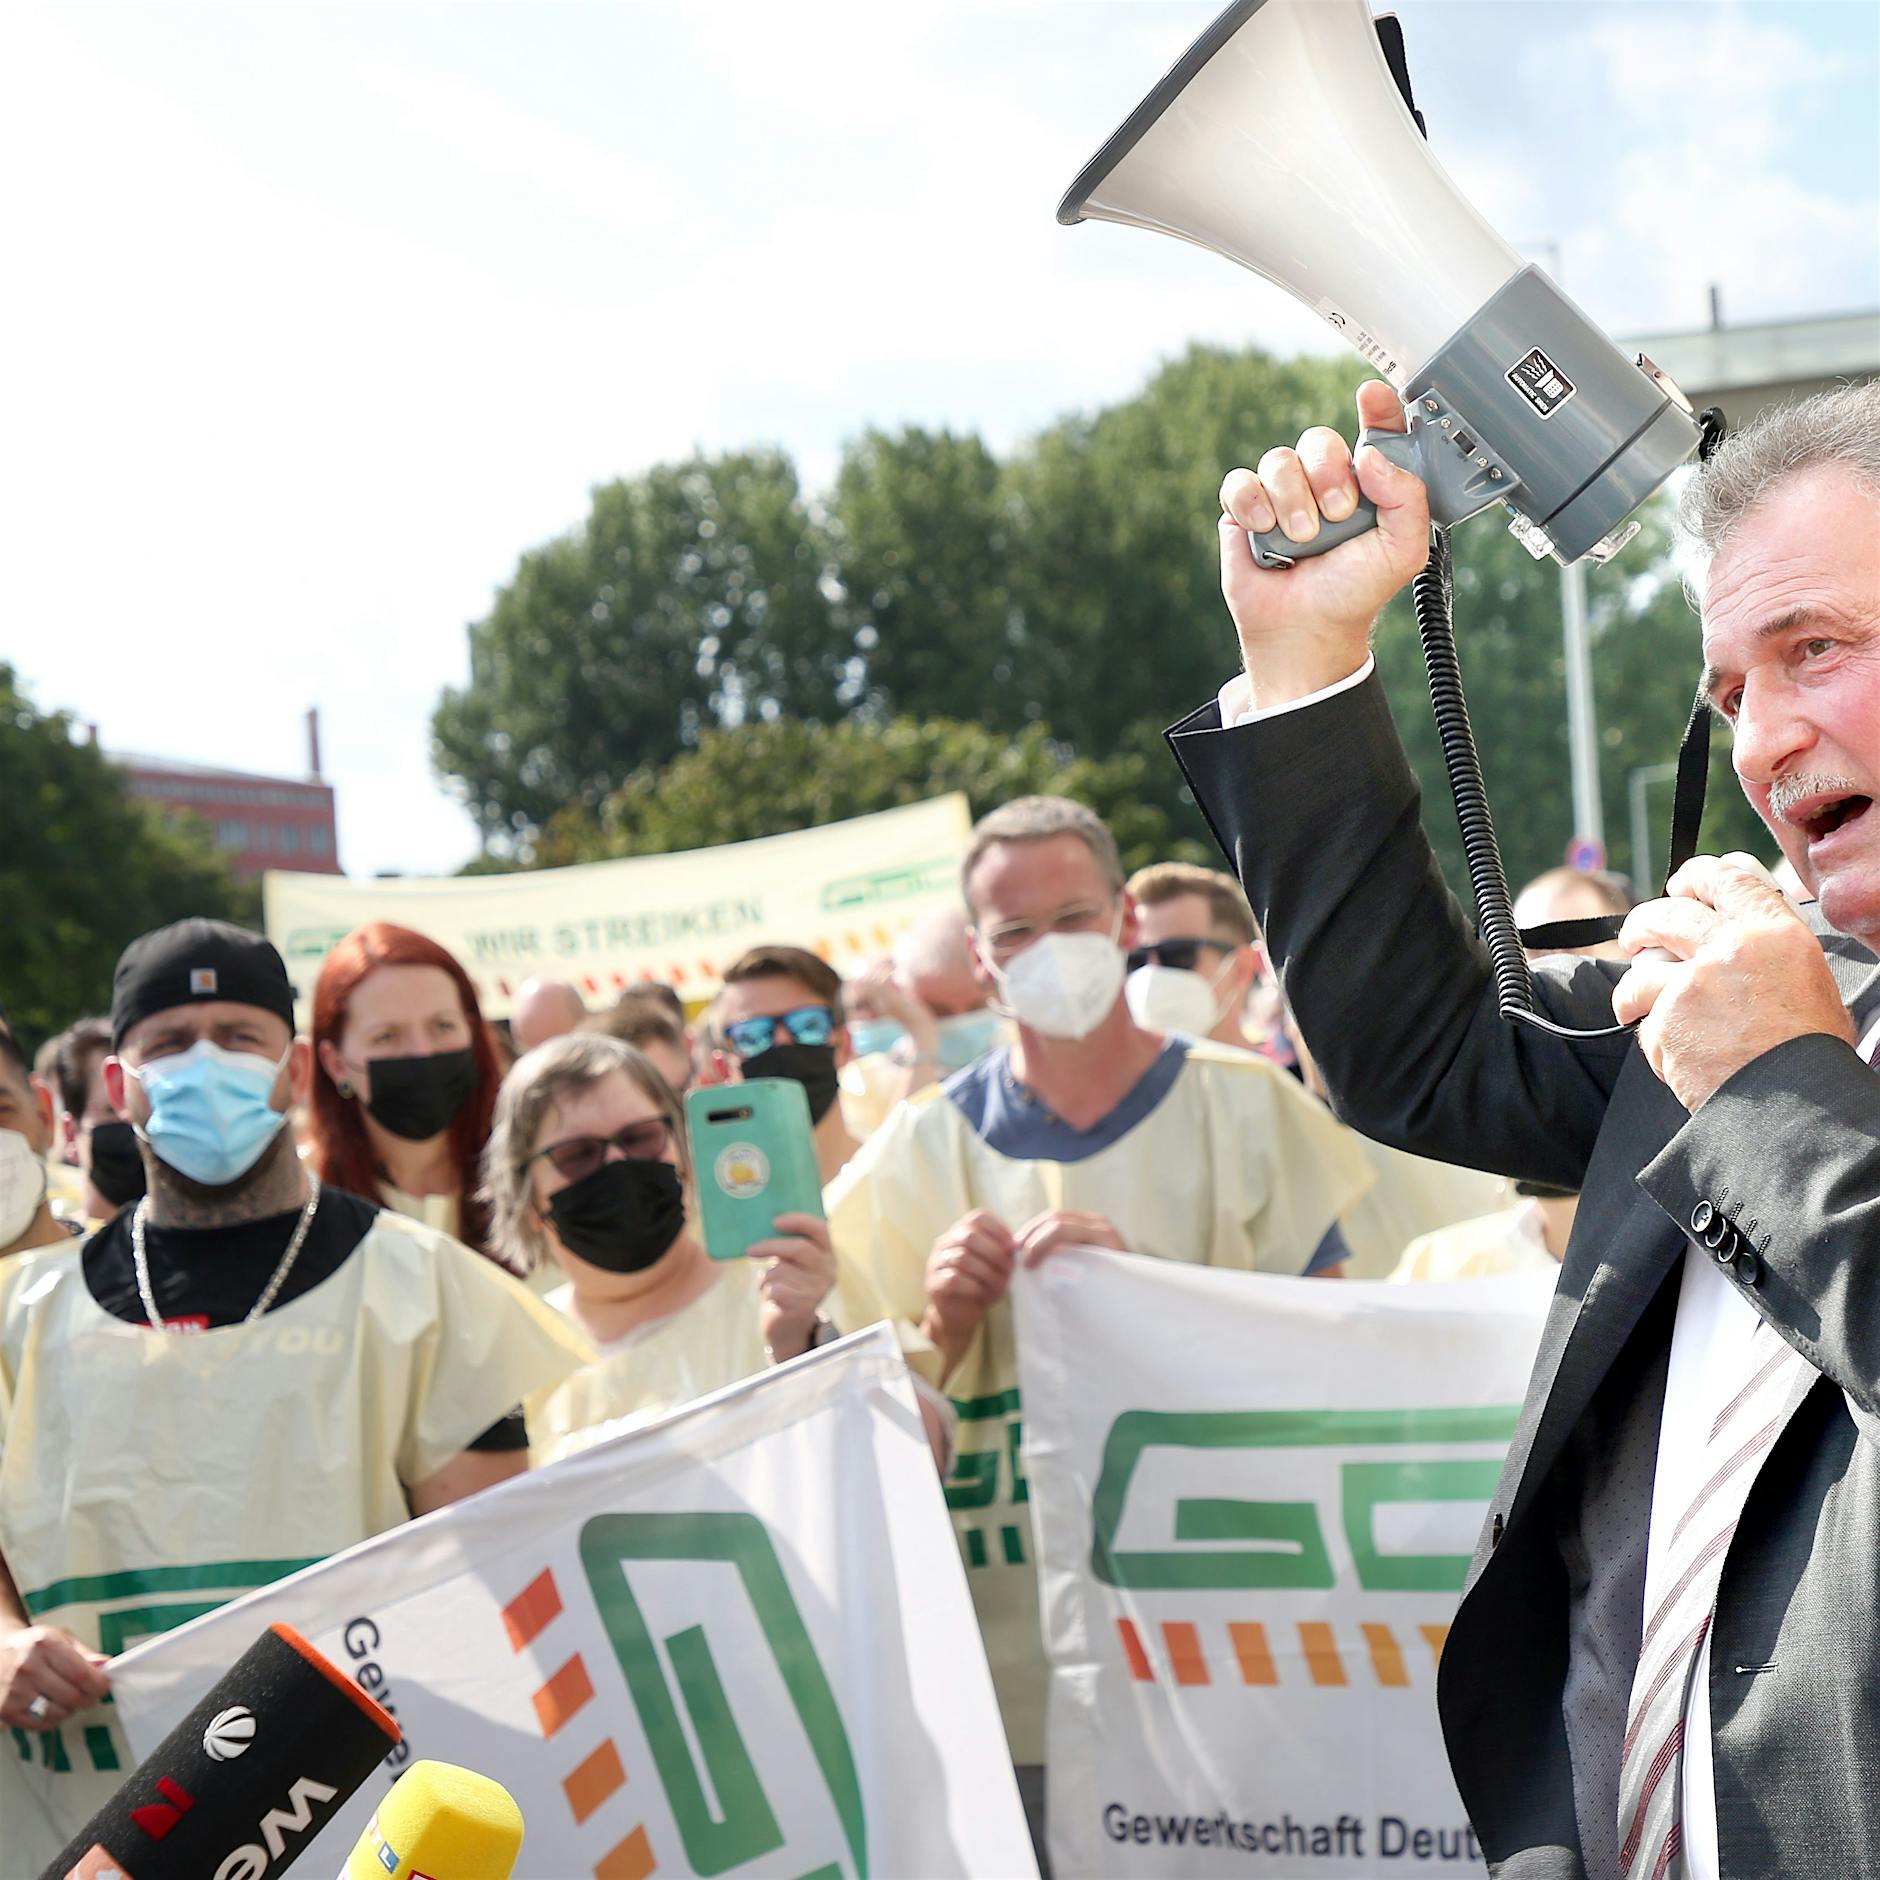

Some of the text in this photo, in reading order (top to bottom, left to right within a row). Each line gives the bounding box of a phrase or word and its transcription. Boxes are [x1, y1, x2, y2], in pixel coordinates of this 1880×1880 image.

[1510, 372, 1550, 413] AUTOMATIC SIREN
[466, 896, 764, 962] WIR STREIKEN
[1090, 1405, 1523, 1592] GD
[1102, 1801, 1483, 1862] Gewerkschaft Deut
